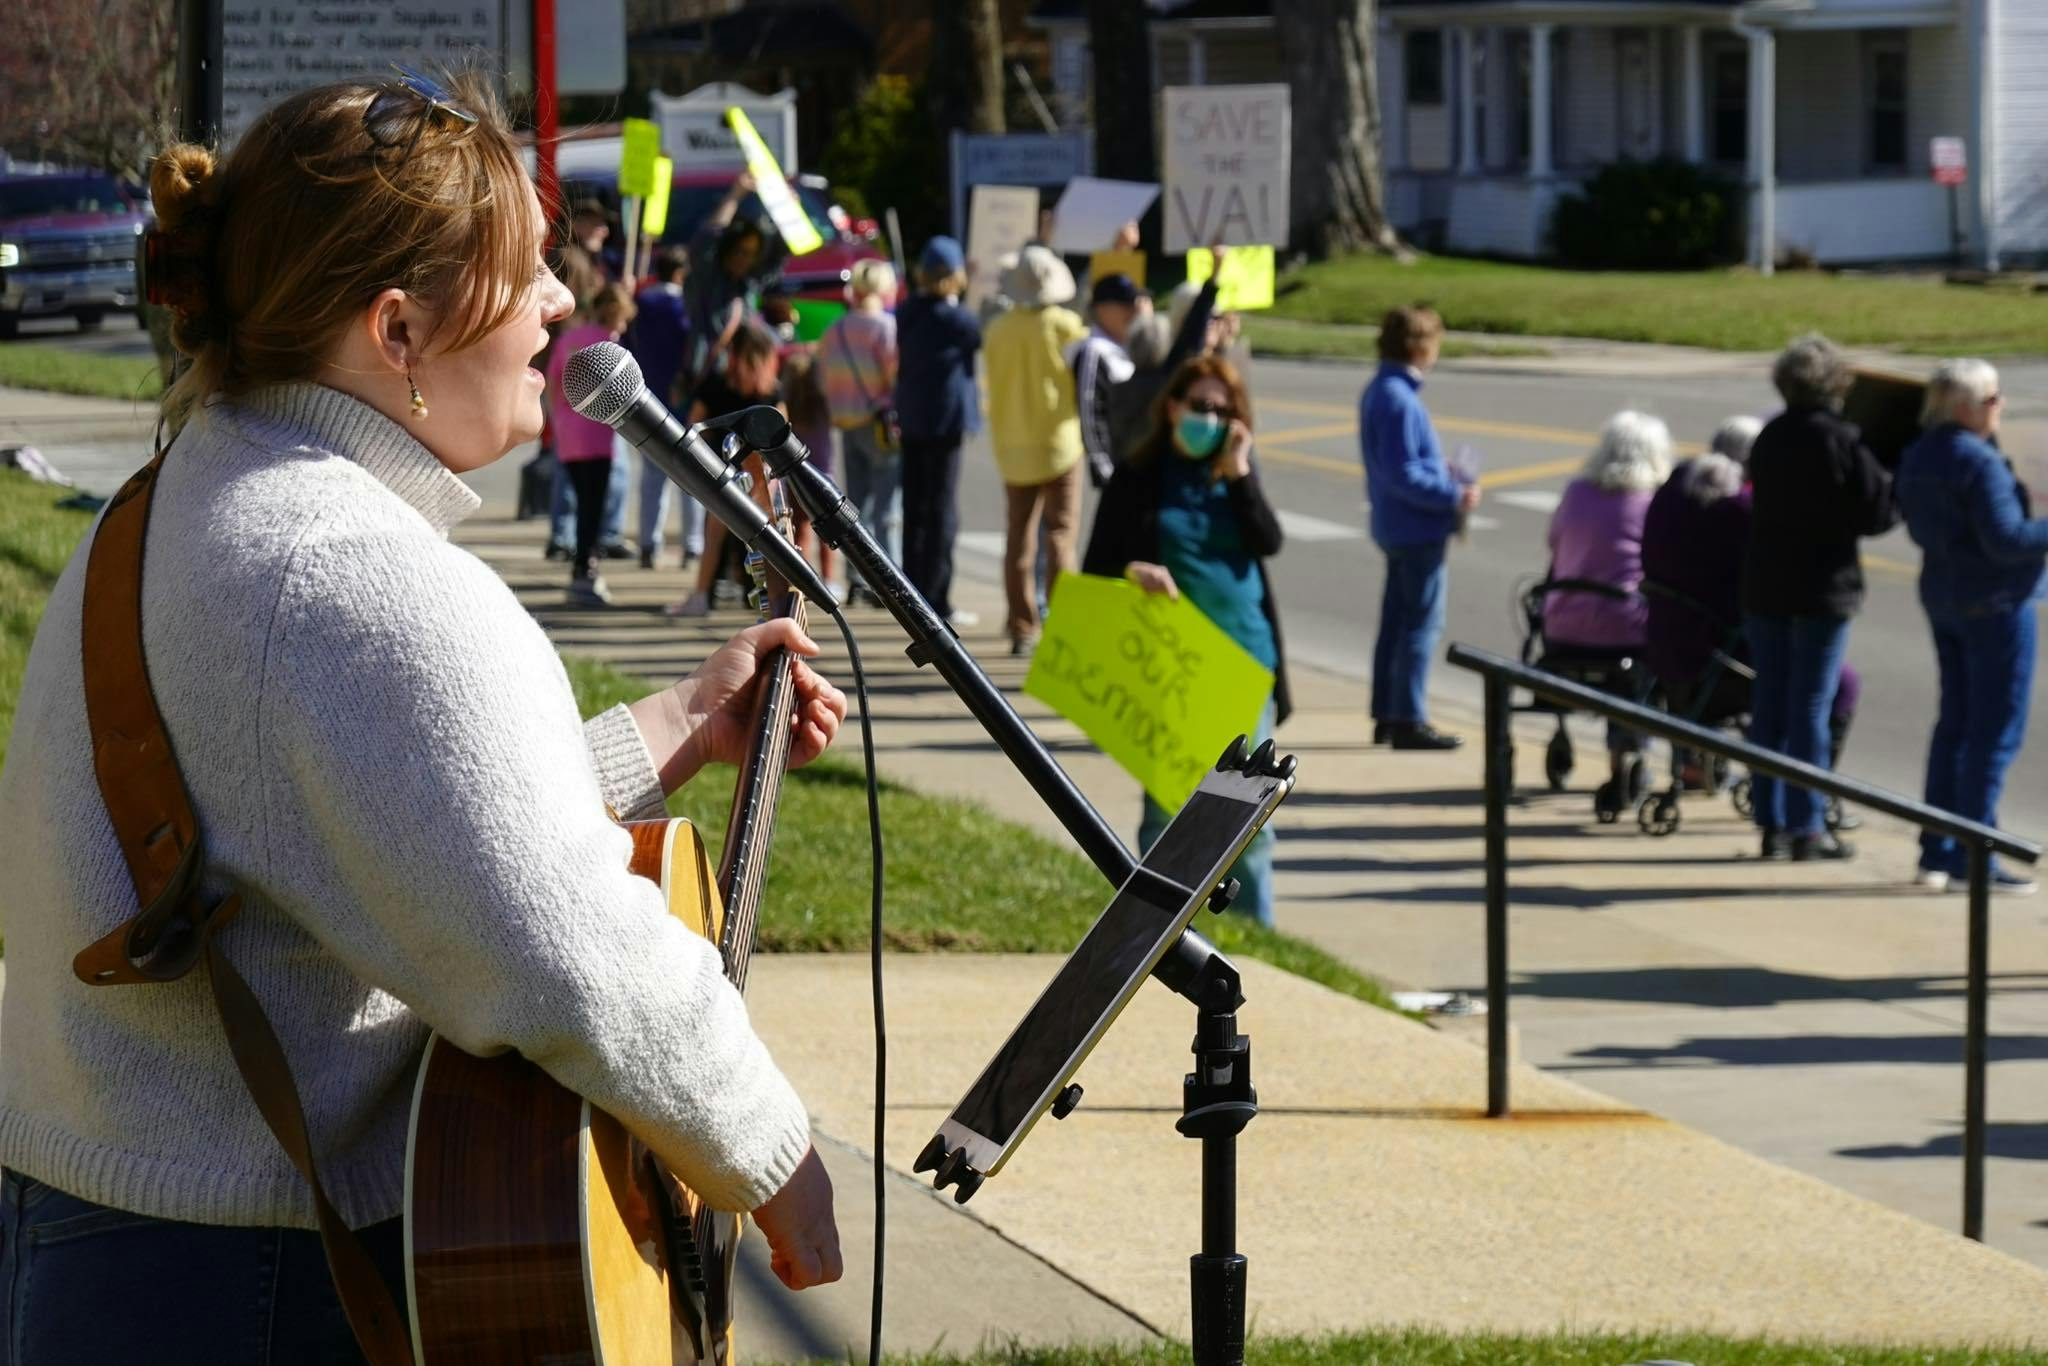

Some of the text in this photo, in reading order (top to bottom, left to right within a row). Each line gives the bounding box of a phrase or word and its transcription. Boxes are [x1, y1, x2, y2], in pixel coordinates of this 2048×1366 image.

[1176, 98, 1274, 146] SAVE
[1201, 152, 1248, 177] THE
[1117, 630, 1190, 720] OUR
